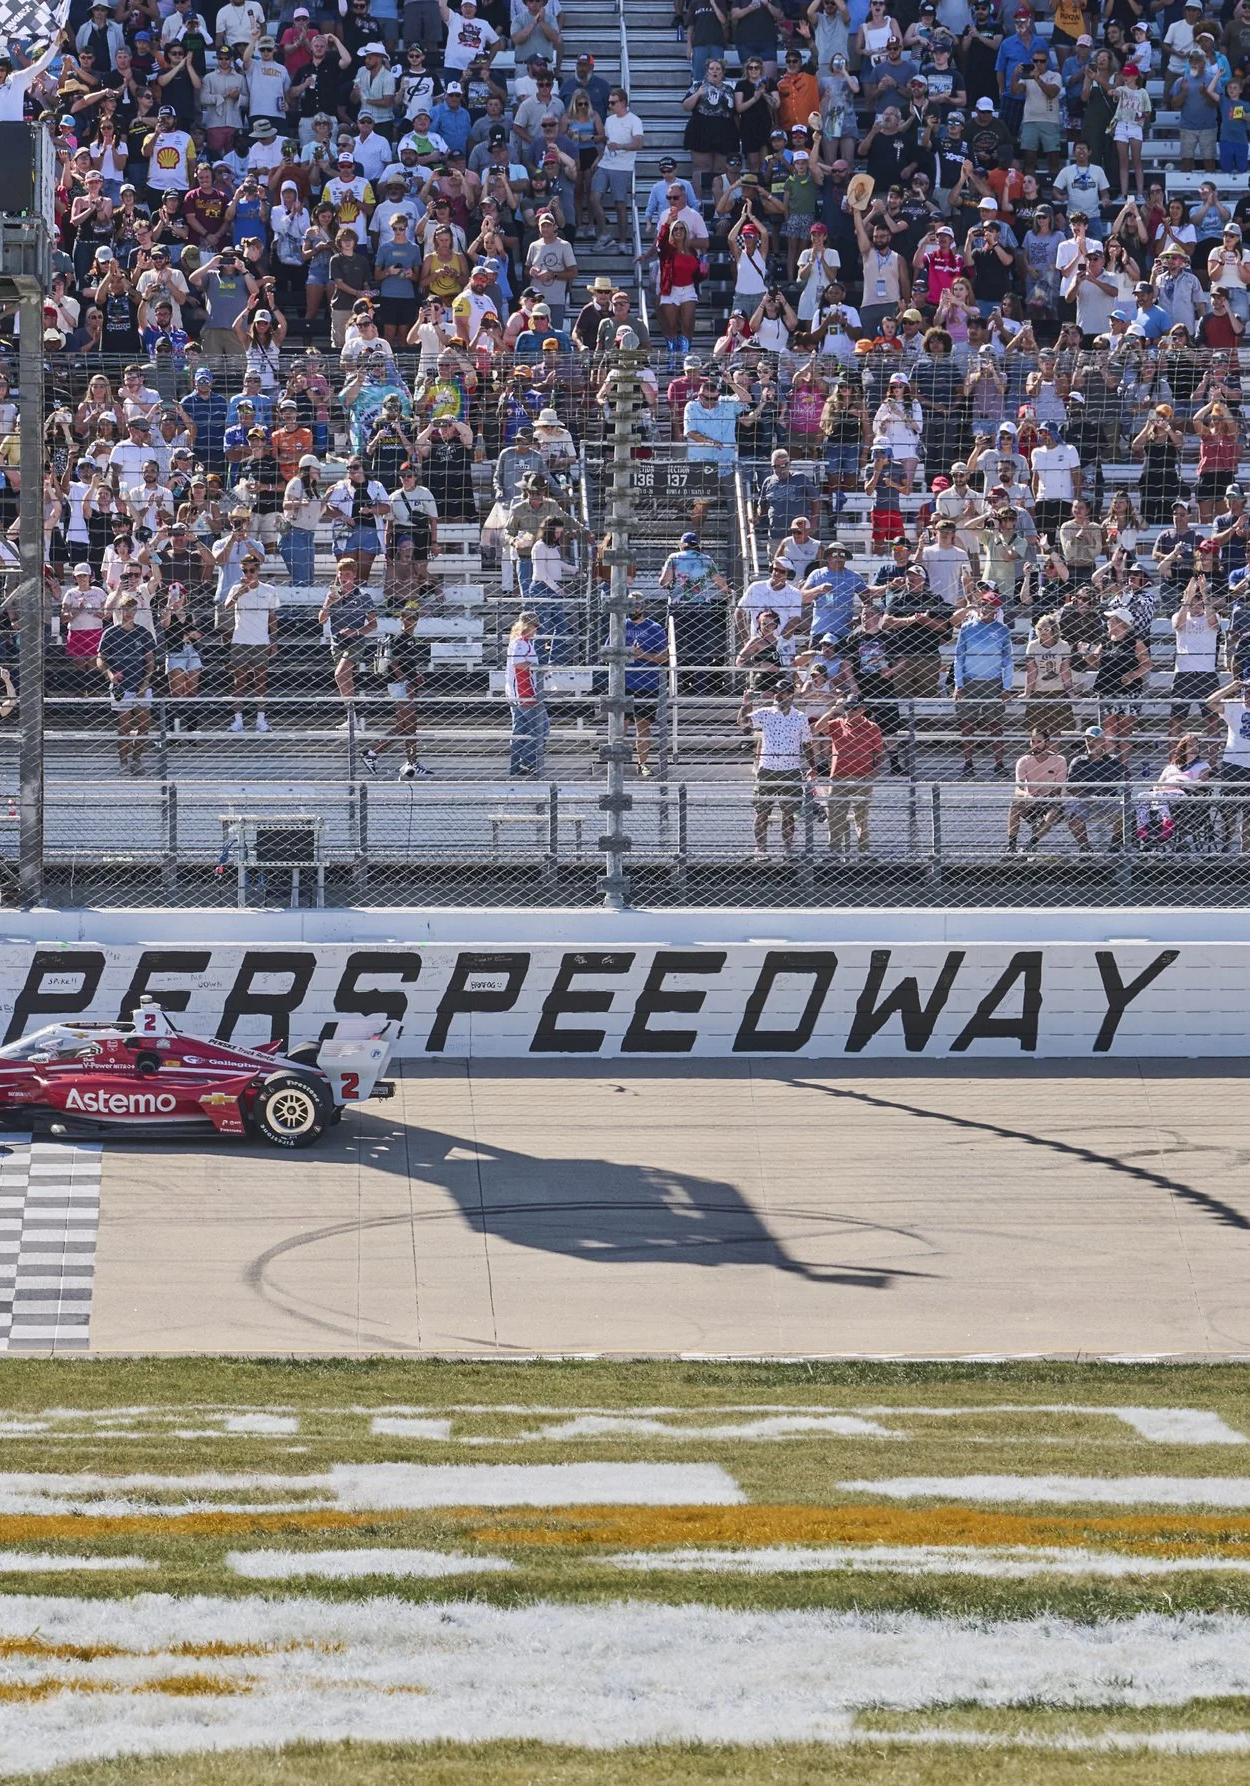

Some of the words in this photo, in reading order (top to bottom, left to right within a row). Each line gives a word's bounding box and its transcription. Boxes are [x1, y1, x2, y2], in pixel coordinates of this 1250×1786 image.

[632, 474, 654, 487] 136
[667, 474, 688, 487] 137
[144, 1013, 157, 1032] 2
[207, 1038, 237, 1051] PENSKE
[235, 1046, 254, 1057] Truck
[252, 1050, 276, 1063] Rental
[83, 1061, 113, 1069] V-Power
[208, 1058, 262, 1069] Gallagher
[286, 1079, 319, 1103] Firestone
[340, 1072, 359, 1099] 2
[65, 1087, 177, 1114] Astemo
[259, 1123, 295, 1147] Firestone
